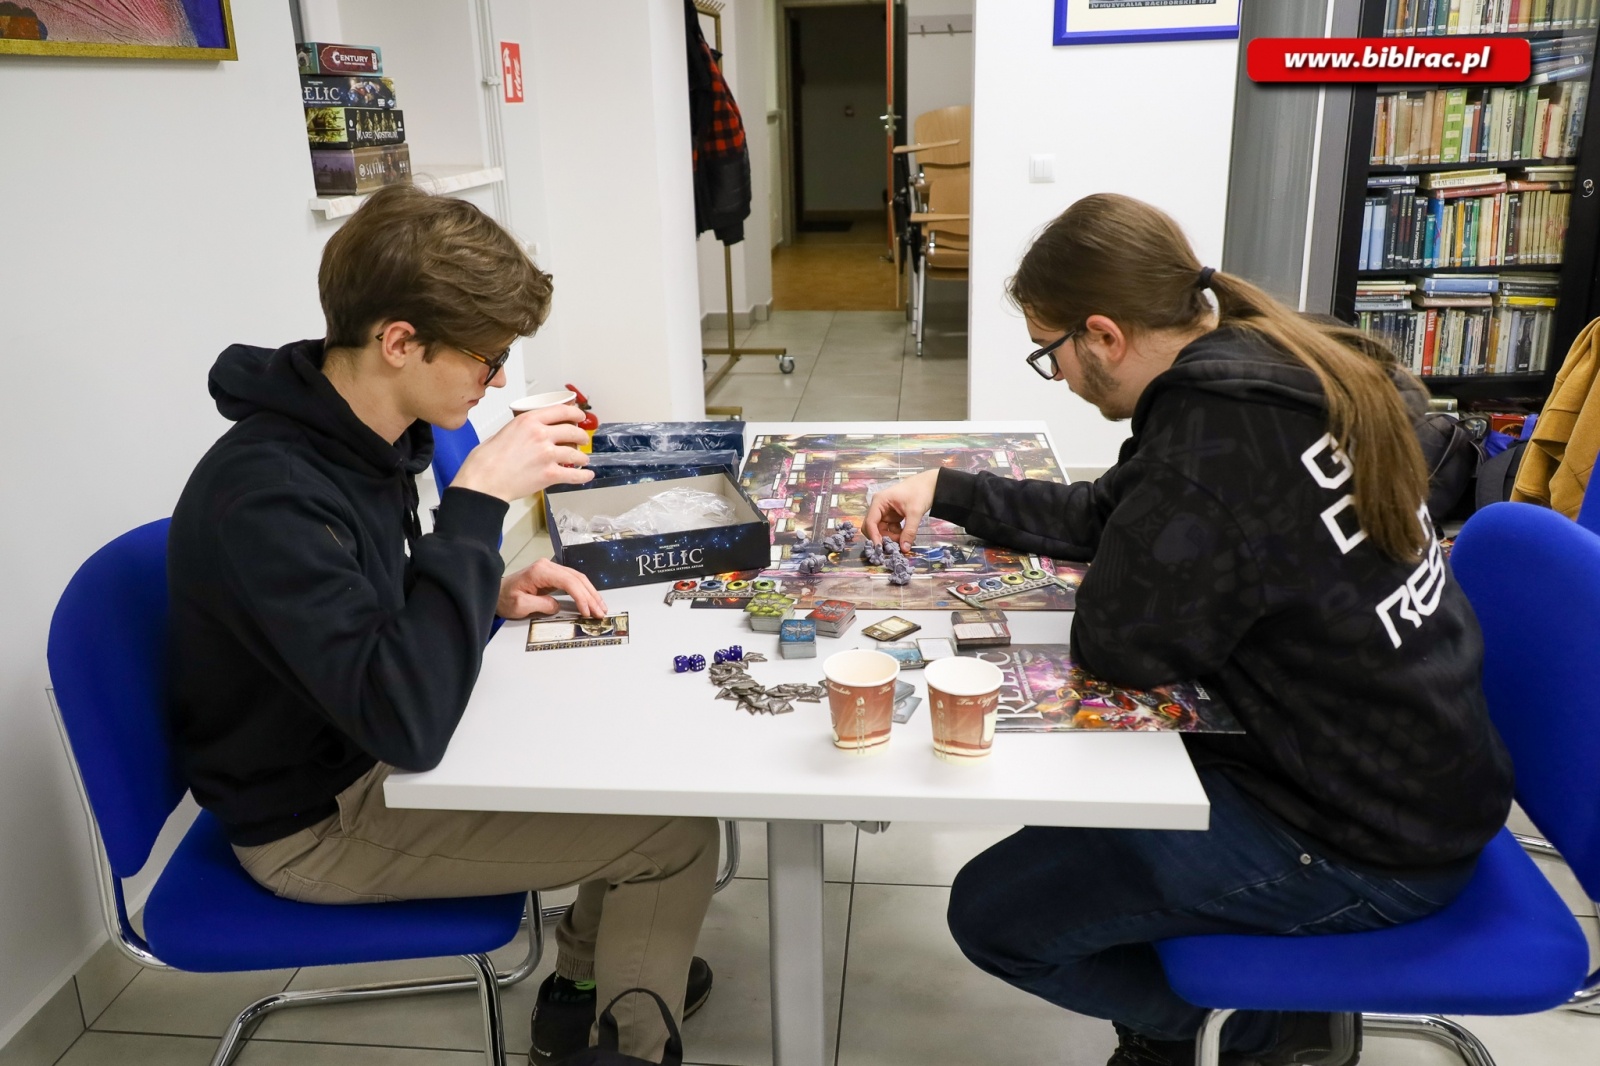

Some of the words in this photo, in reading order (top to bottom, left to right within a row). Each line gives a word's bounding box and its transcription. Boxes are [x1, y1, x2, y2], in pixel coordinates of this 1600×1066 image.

[331, 50, 368, 65] CENTURY
[302, 86, 341, 101] ELIC
[635, 548, 704, 577] RELIC
